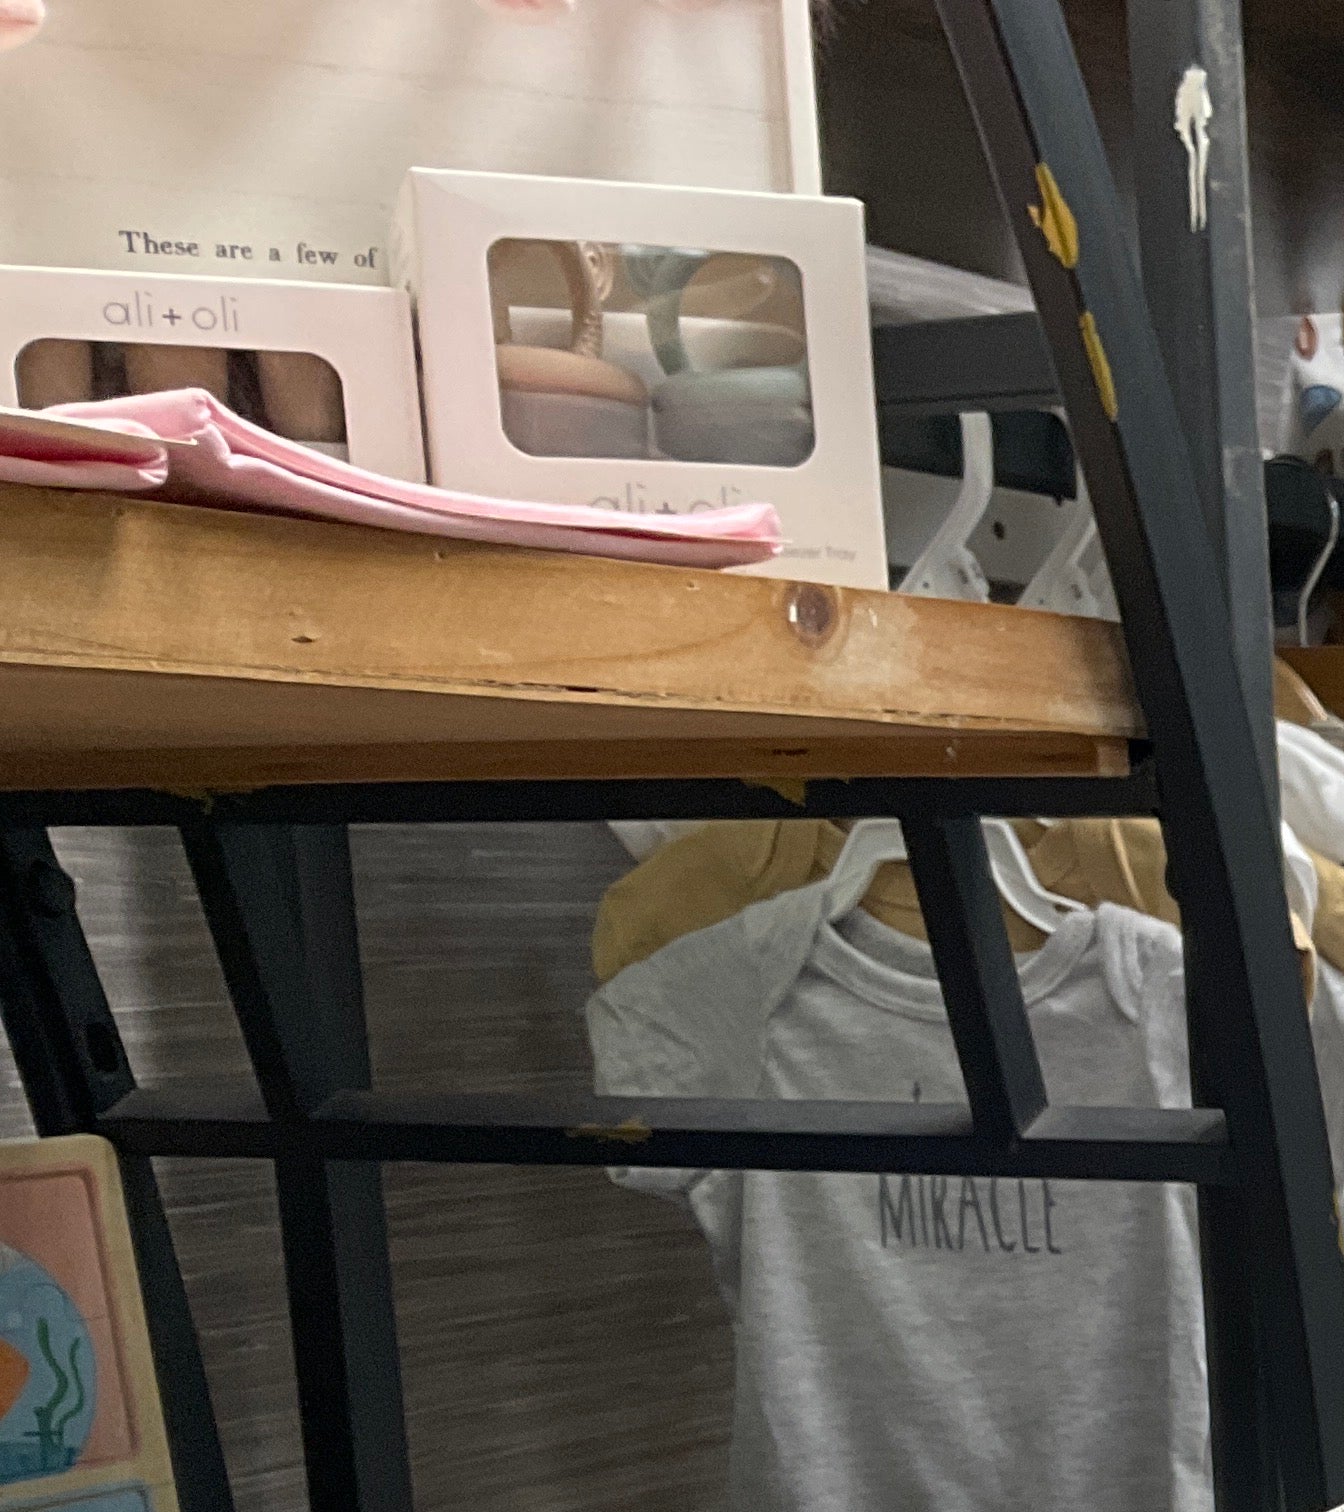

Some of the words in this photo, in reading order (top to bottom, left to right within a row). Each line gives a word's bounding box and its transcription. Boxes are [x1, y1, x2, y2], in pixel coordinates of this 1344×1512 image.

[118, 229, 200, 258] These
[215, 242, 253, 261] are
[268, 247, 281, 263] a
[296, 241, 339, 266] few
[353, 246, 379, 269] of
[877, 1175, 1063, 1256] MIRACLE
